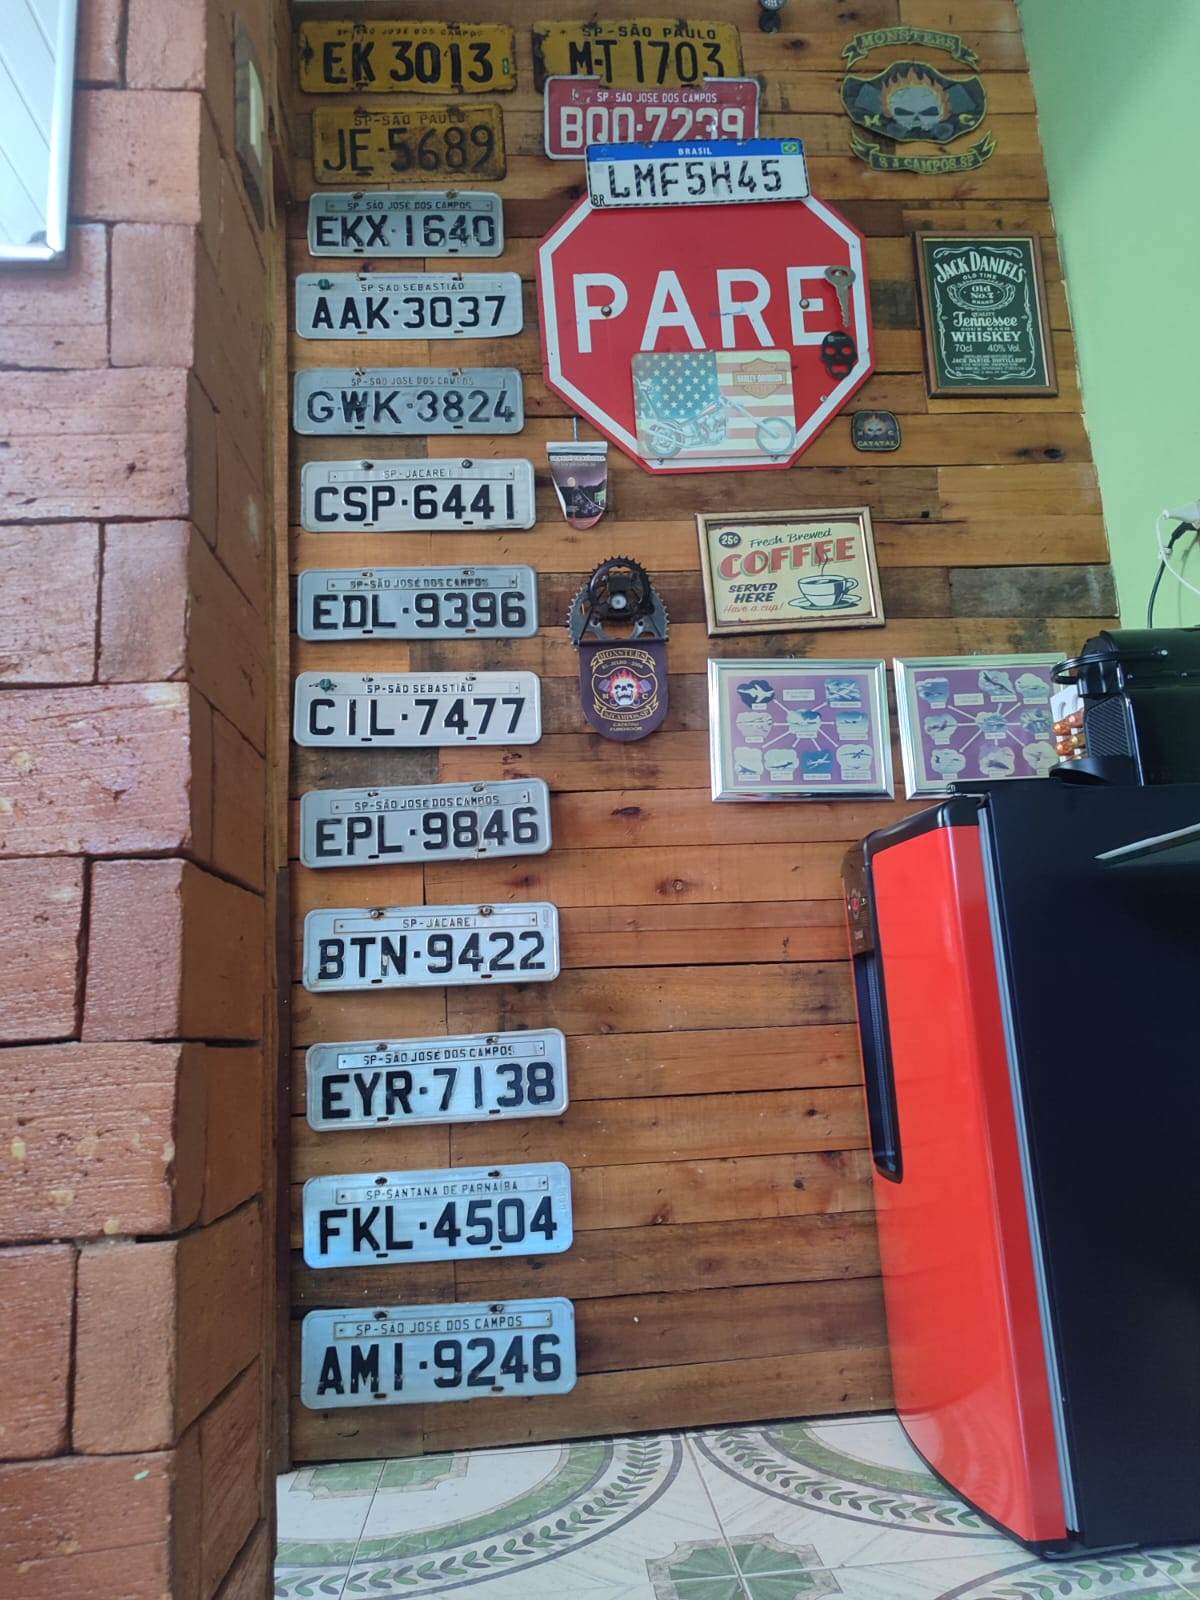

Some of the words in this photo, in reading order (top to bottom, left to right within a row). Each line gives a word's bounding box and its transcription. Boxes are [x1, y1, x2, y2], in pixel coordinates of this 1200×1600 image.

[662, 26, 717, 39] PAULO
[859, 31, 957, 50] MONSTERS
[389, 41, 494, 84] 3013
[632, 40, 725, 85] 1703
[662, 93, 679, 103] DOS
[682, 92, 718, 104] CAMPOS
[419, 112, 466, 126] PAULO
[677, 146, 713, 156] BRASIL
[607, 159, 783, 199] LMF5H45
[413, 201, 433, 210] DOS
[435, 200, 473, 210] CAMPOS
[592, 193, 606, 208] BR
[933, 256, 967, 283] JACK
[969, 250, 1027, 283] DANIEL'S
[979, 272, 998, 280] TIME
[360, 283, 374, 292] SP
[971, 284, 992, 293] Old
[572, 265, 834, 353] PARE
[952, 311, 1019, 327] Tennessee
[950, 331, 1022, 343] WHISKEY
[954, 344, 973, 352] 70cl
[987, 344, 1006, 352] 40%
[750, 535, 785, 549] Fresh
[786, 528, 833, 544] Brewed
[717, 536, 857, 580] COFFEE
[423, 578, 445, 588] DOS
[445, 577, 489, 588] CAMPOS
[727, 582, 779, 594] SERVED
[733, 591, 776, 604] HERE
[722, 603, 749, 614] Have
[760, 602, 785, 613] cup!
[431, 797, 454, 808] DOS
[455, 795, 500, 807] CAMPOS
[444, 1049, 467, 1060] DOS
[469, 1045, 515, 1058] CAMPOS
[442, 1184, 457, 1196] DE
[446, 1318, 470, 1331] DOS
[474, 1315, 523, 1330] CAMPOS
